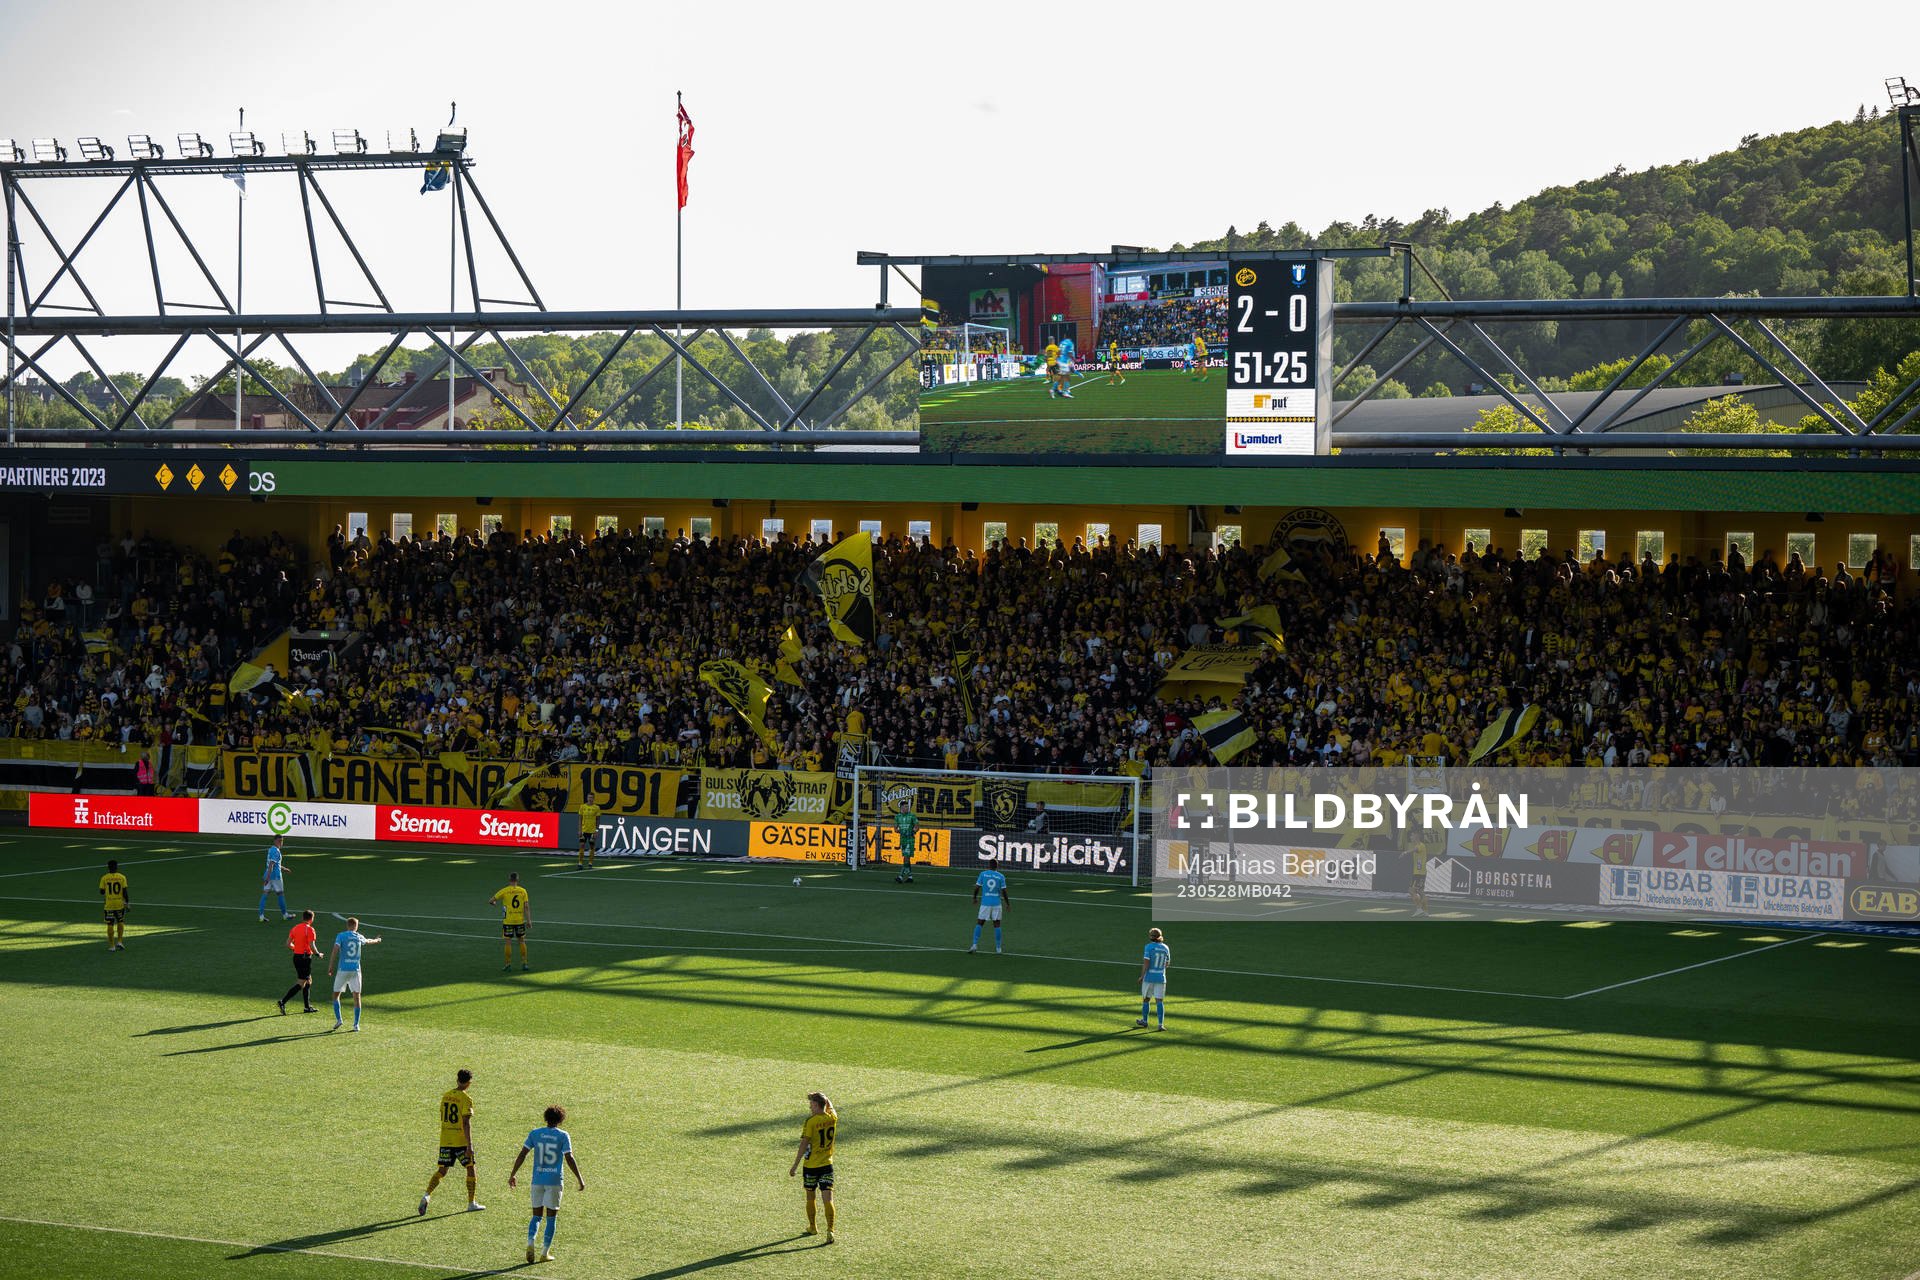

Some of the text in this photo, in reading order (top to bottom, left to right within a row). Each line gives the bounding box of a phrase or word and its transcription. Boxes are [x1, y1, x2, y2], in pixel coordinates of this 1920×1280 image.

[1237, 295, 1254, 333] 2
[1289, 294, 1307, 332] 0
[1240, 433, 1283, 445] Lambert
[0, 467, 106, 487] PARTNERS 2023
[580, 767, 662, 815] 1991
[706, 791, 825, 813] 2013 2023
[93, 811, 153, 827] Infrakraft
[598, 817, 712, 853] TÅNGEN
[805, 851, 817, 859] EN
[106, 882, 121, 895] 10
[986, 878, 997, 892] 9
[1476, 870, 1553, 889] BORGSTENA
[1647, 870, 1713, 893] UBAB
[1764, 877, 1832, 900] UBAB
[511, 895, 520, 909] 6
[1475, 888, 1515, 898] OF SWEDEN
[1858, 890, 1918, 914] EAB
[1823, 904, 1833, 914] AB
[346, 941, 357, 957] 3
[444, 1102, 459, 1124] 18
[818, 1126, 835, 1149] 19
[537, 1142, 558, 1166] 15
